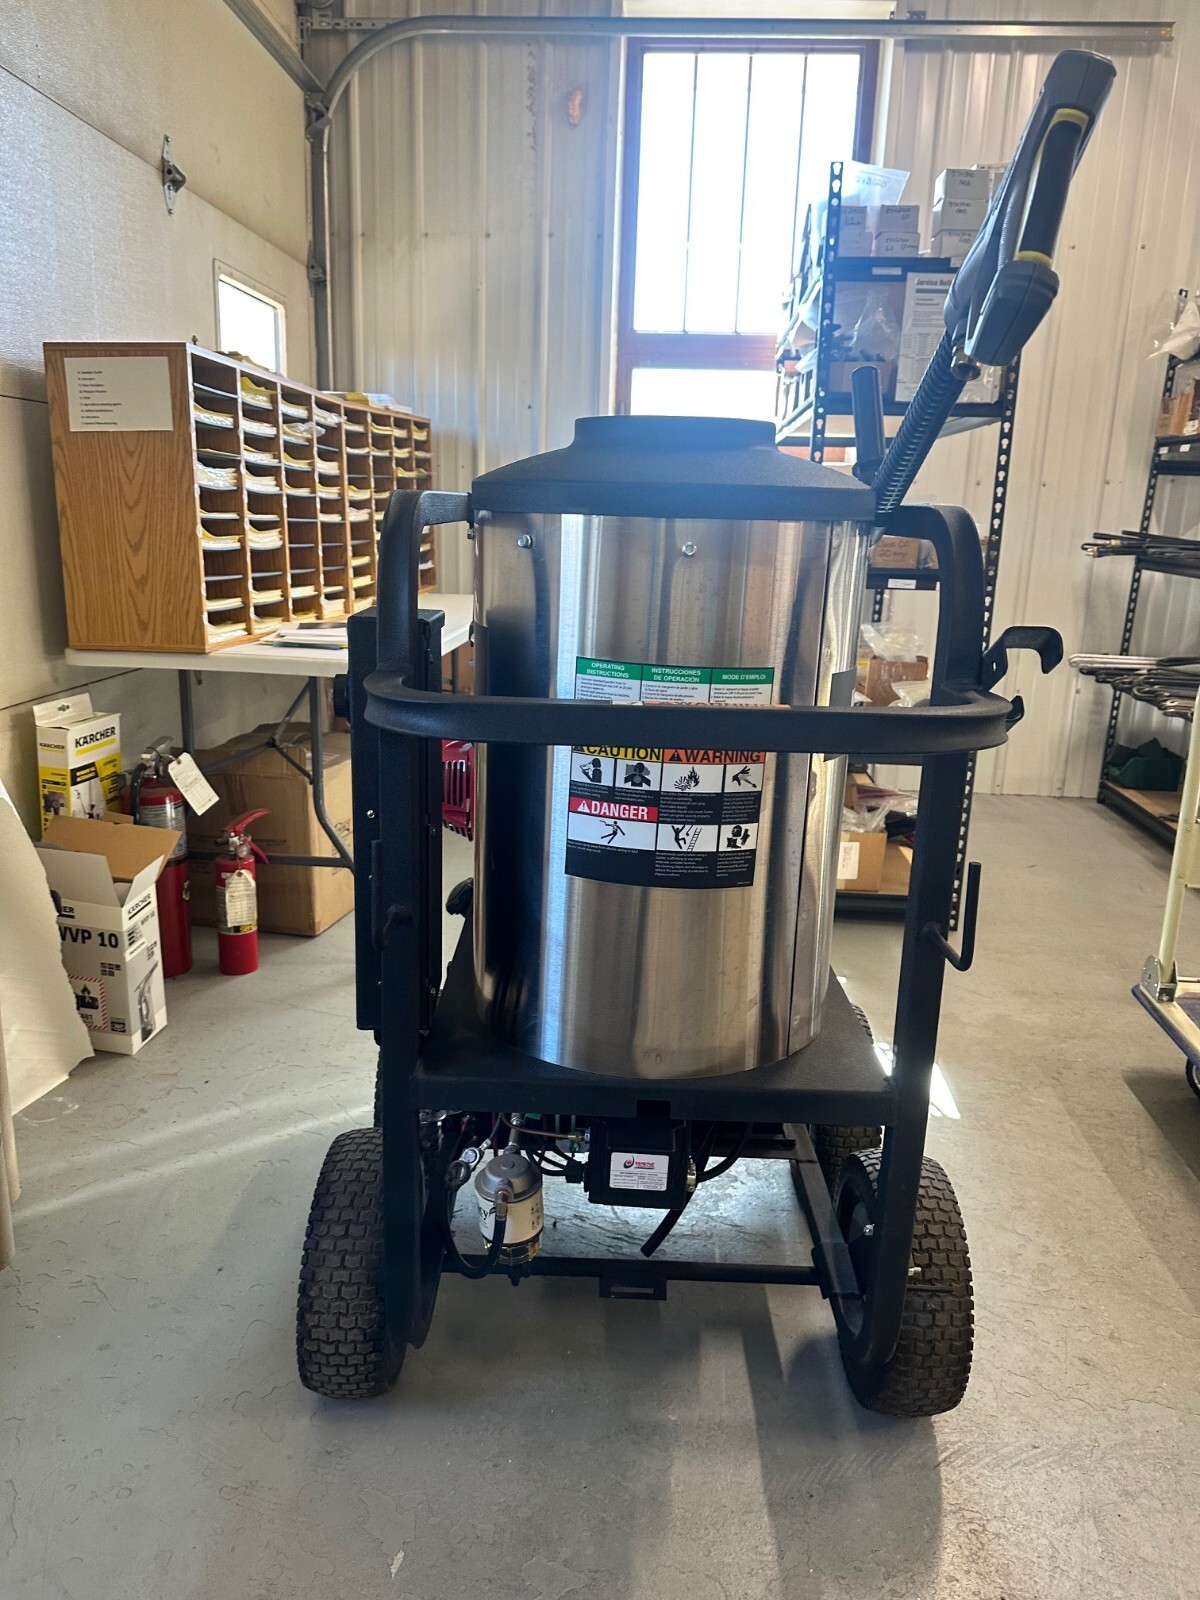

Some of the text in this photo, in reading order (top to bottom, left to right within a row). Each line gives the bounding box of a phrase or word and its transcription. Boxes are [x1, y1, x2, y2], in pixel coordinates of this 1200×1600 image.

[591, 662, 625, 671] OPERATING
[651, 667, 701, 676] INSTRUCCIONES
[586, 669, 630, 678] INSTRUCTIONS
[663, 675, 700, 683] OPERACIÓN
[586, 746, 660, 761] CAUTION
[685, 748, 761, 764] WARNING
[591, 801, 648, 820] DANGER
[97, 931, 119, 949] 10
